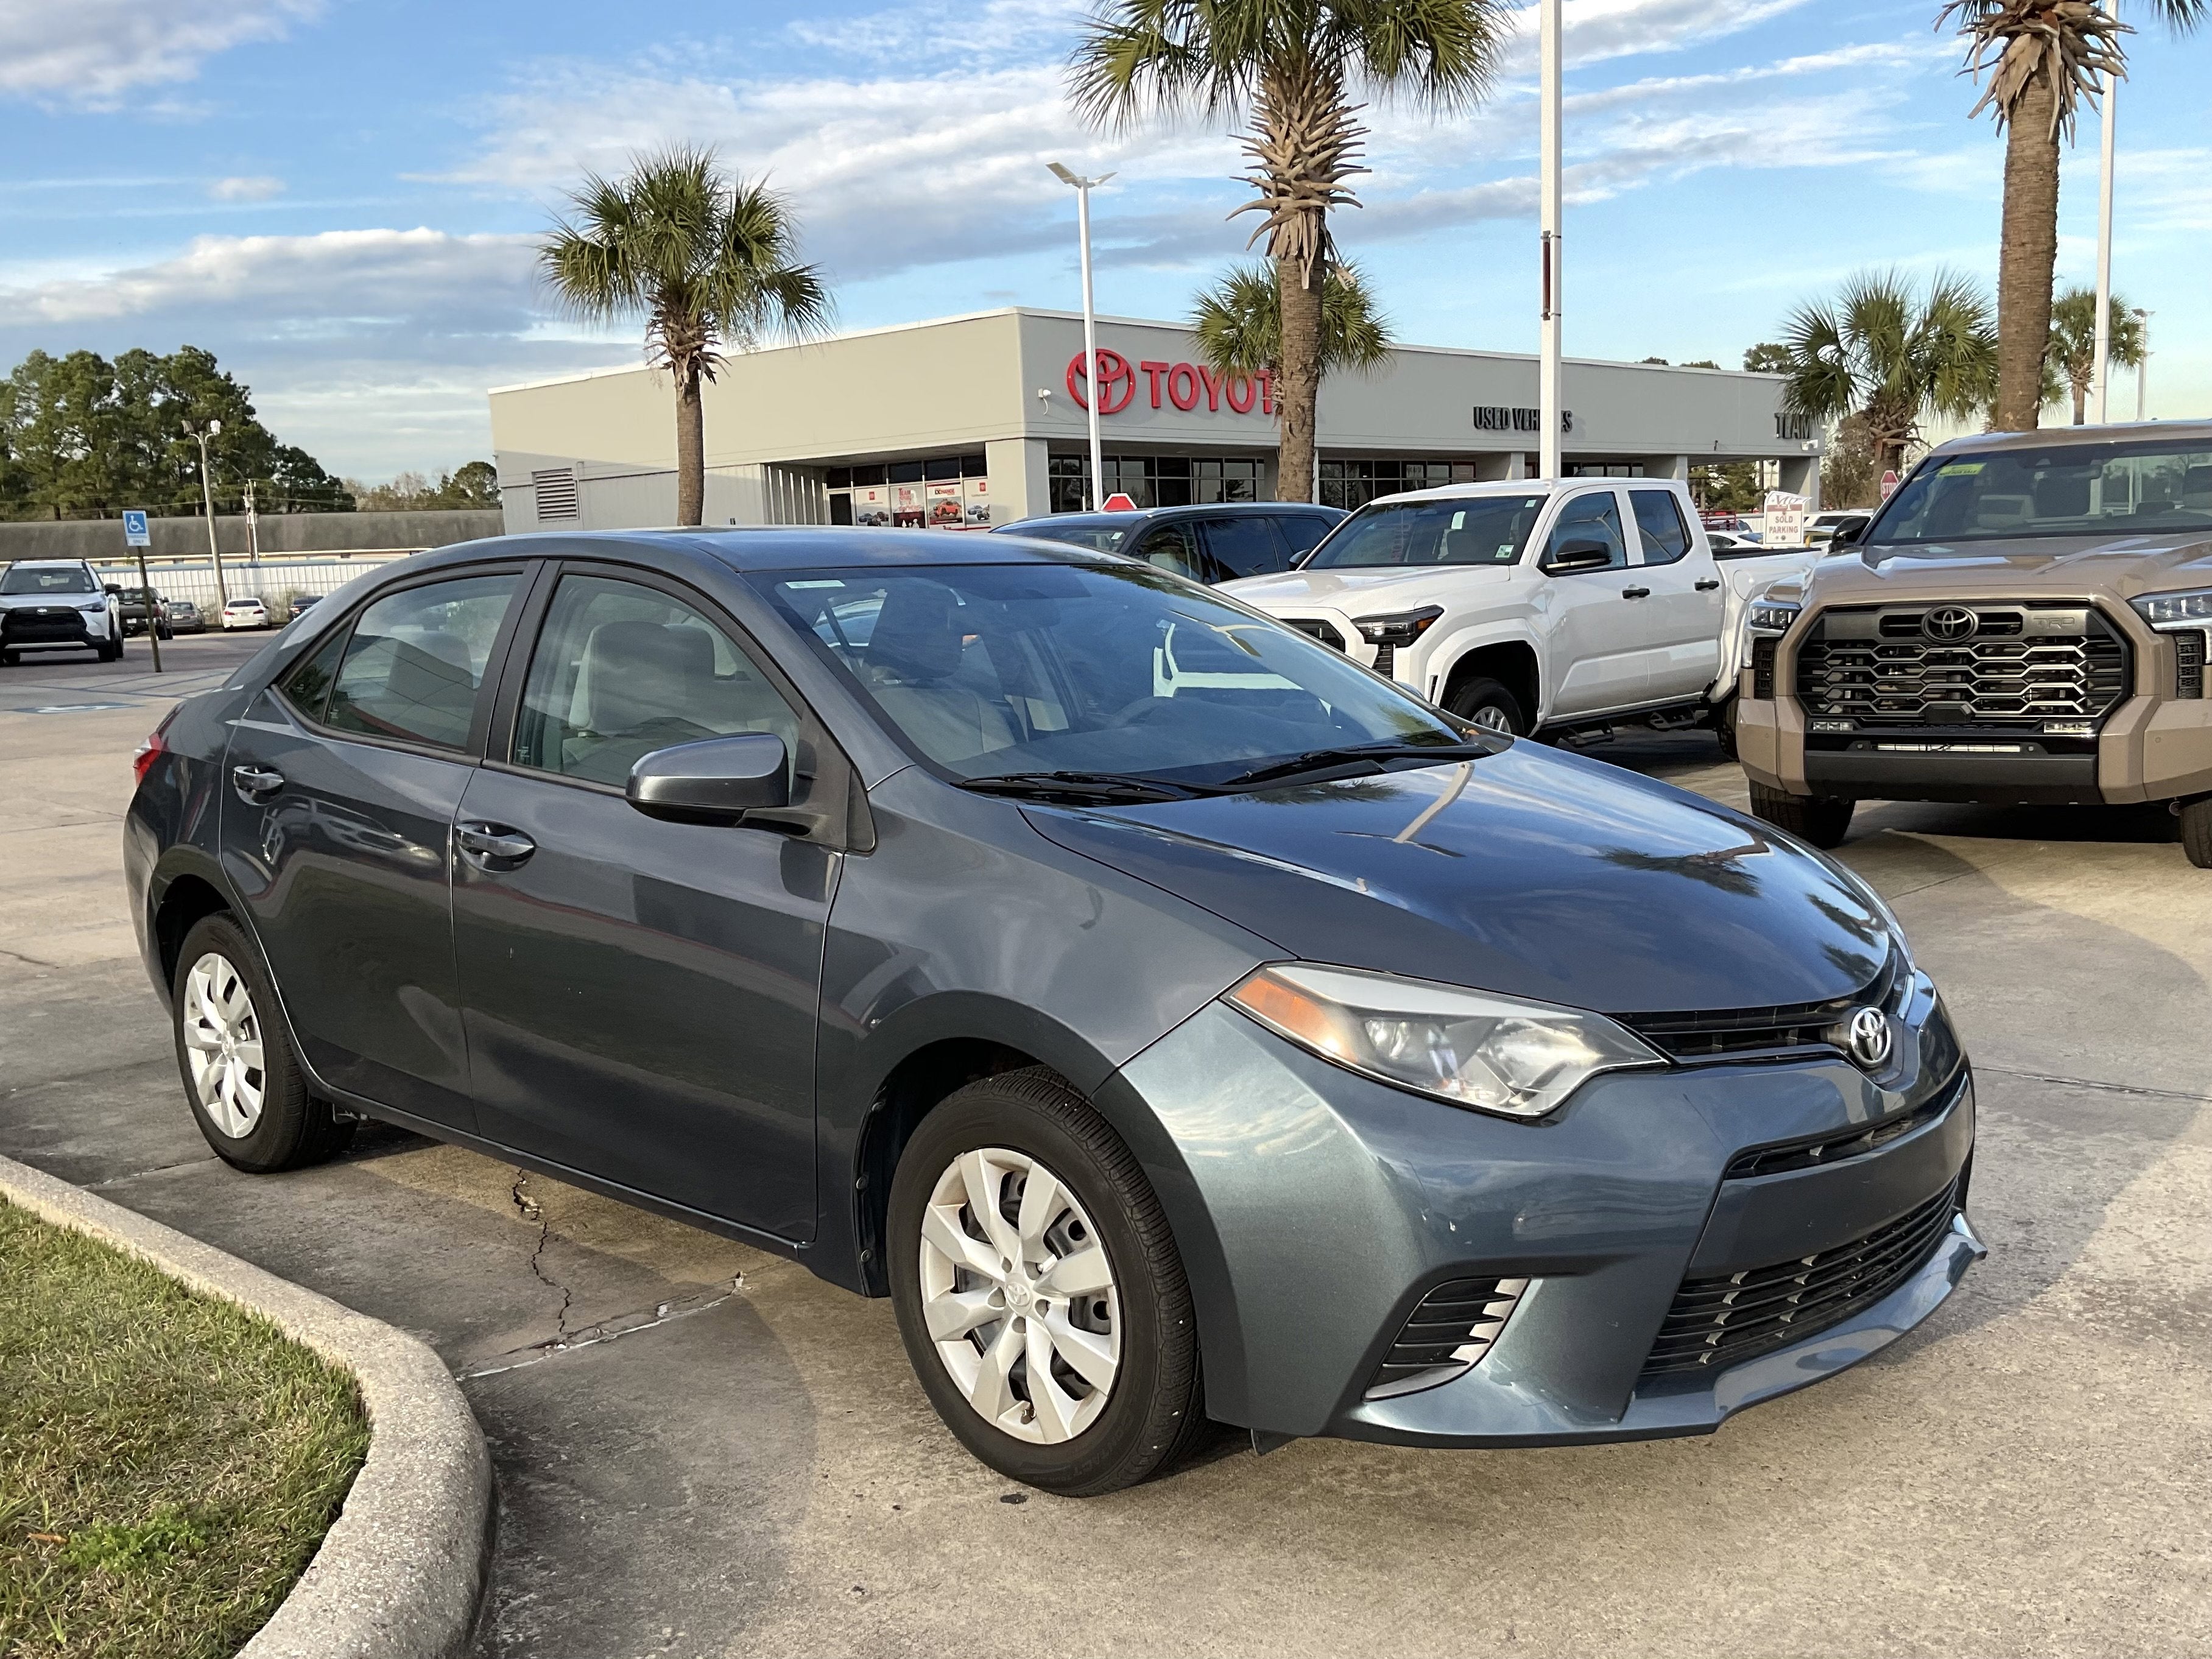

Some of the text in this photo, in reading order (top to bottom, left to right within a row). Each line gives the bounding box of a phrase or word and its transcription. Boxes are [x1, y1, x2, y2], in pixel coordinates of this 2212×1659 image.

[1141, 361, 1277, 414] TOYOT
[1473, 406, 1510, 429] USED
[2033, 617, 2075, 629] TRD
